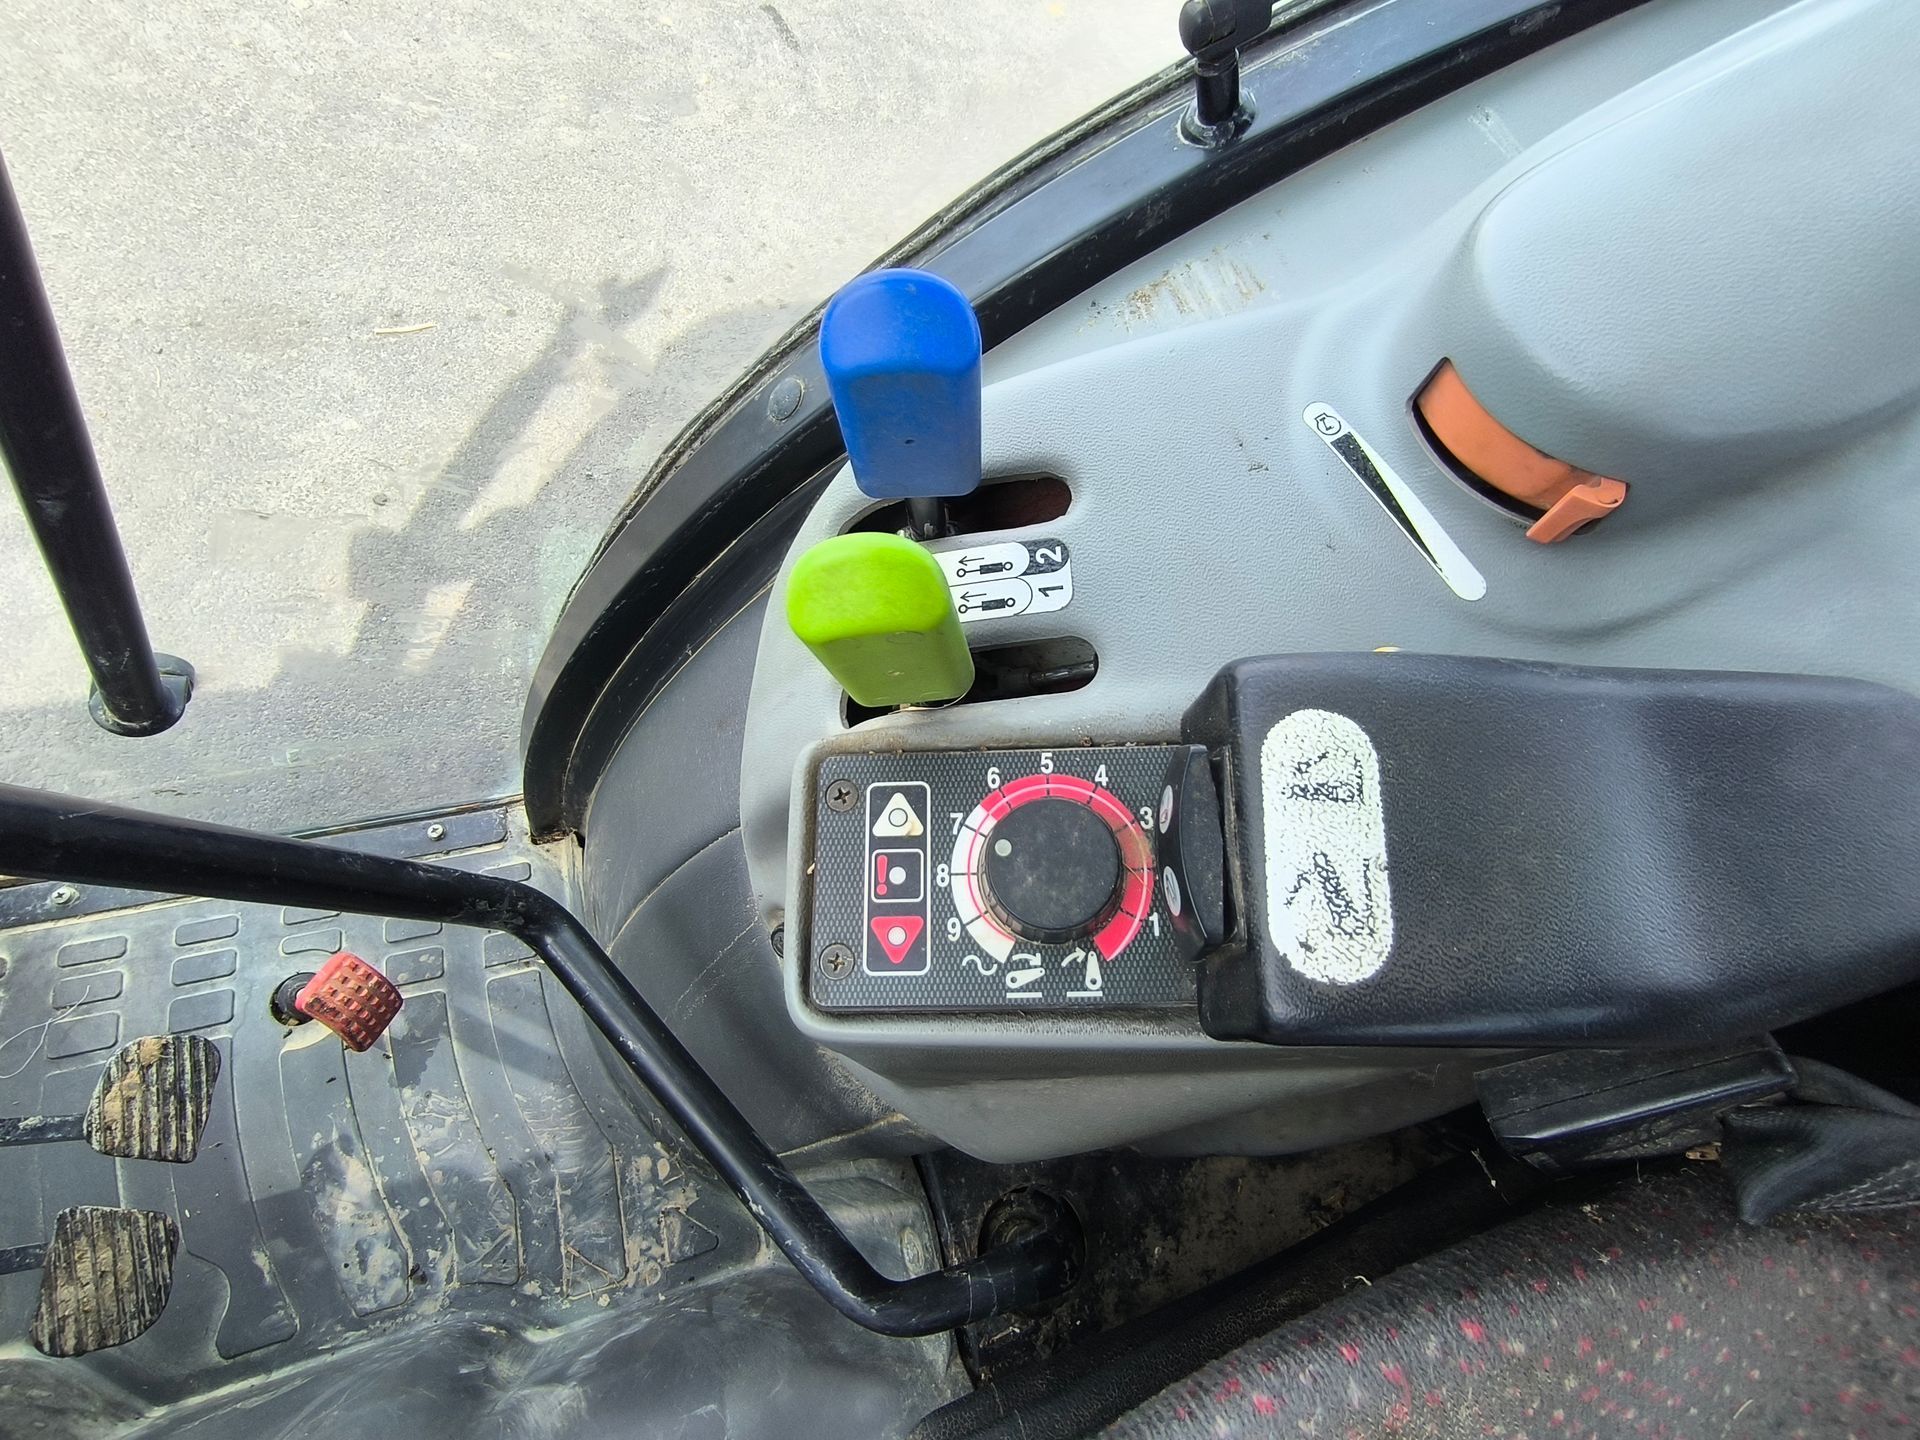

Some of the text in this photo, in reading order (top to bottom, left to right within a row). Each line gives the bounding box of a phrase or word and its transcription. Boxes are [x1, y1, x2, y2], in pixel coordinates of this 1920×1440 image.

[1035, 545, 1062, 564] 2
[1041, 753, 1054, 773] 5
[986, 767, 1000, 789] 6
[1094, 765, 1108, 787] 4
[950, 813, 963, 835] 7
[1139, 807, 1154, 828] 3
[936, 864, 950, 886] 8
[947, 917, 962, 941] 9
[1148, 912, 1160, 936] 1
